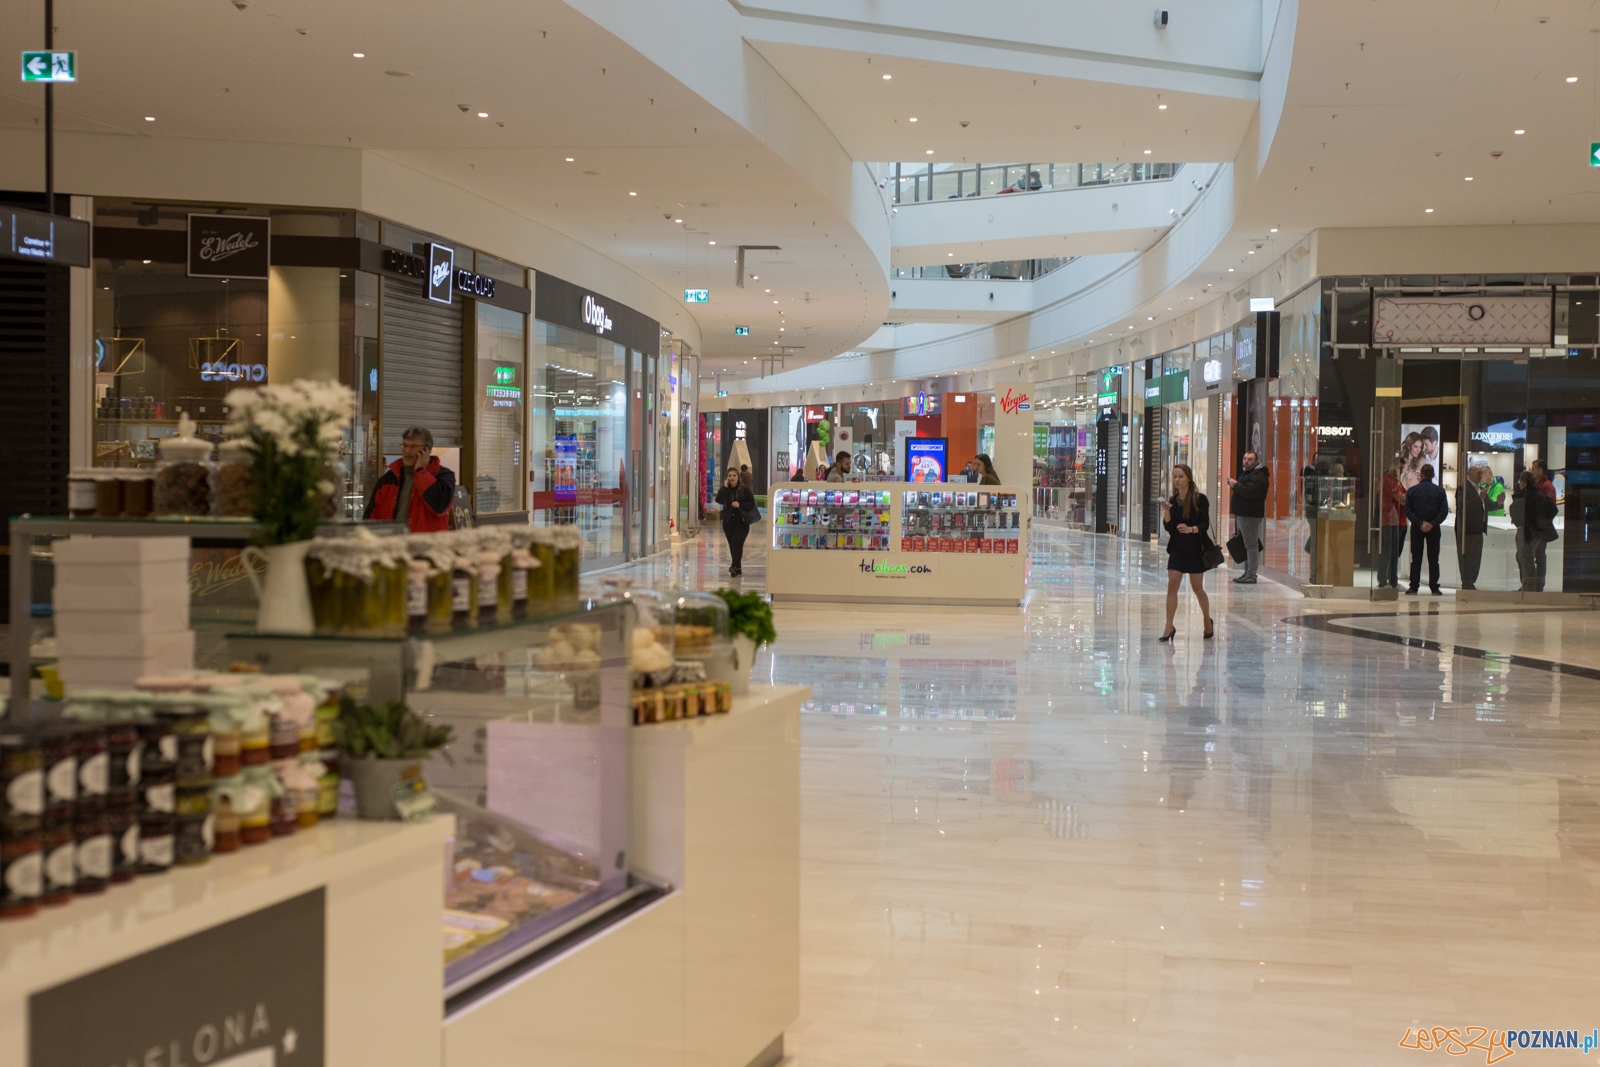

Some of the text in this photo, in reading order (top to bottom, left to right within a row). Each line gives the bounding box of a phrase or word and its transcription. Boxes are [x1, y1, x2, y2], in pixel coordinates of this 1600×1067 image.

[1000, 388, 1029, 415] Virgin
[1315, 426, 1353, 436] TISSOT
[1471, 432, 1513, 440] LONGINES
[859, 558, 932, 574] telakces.com
